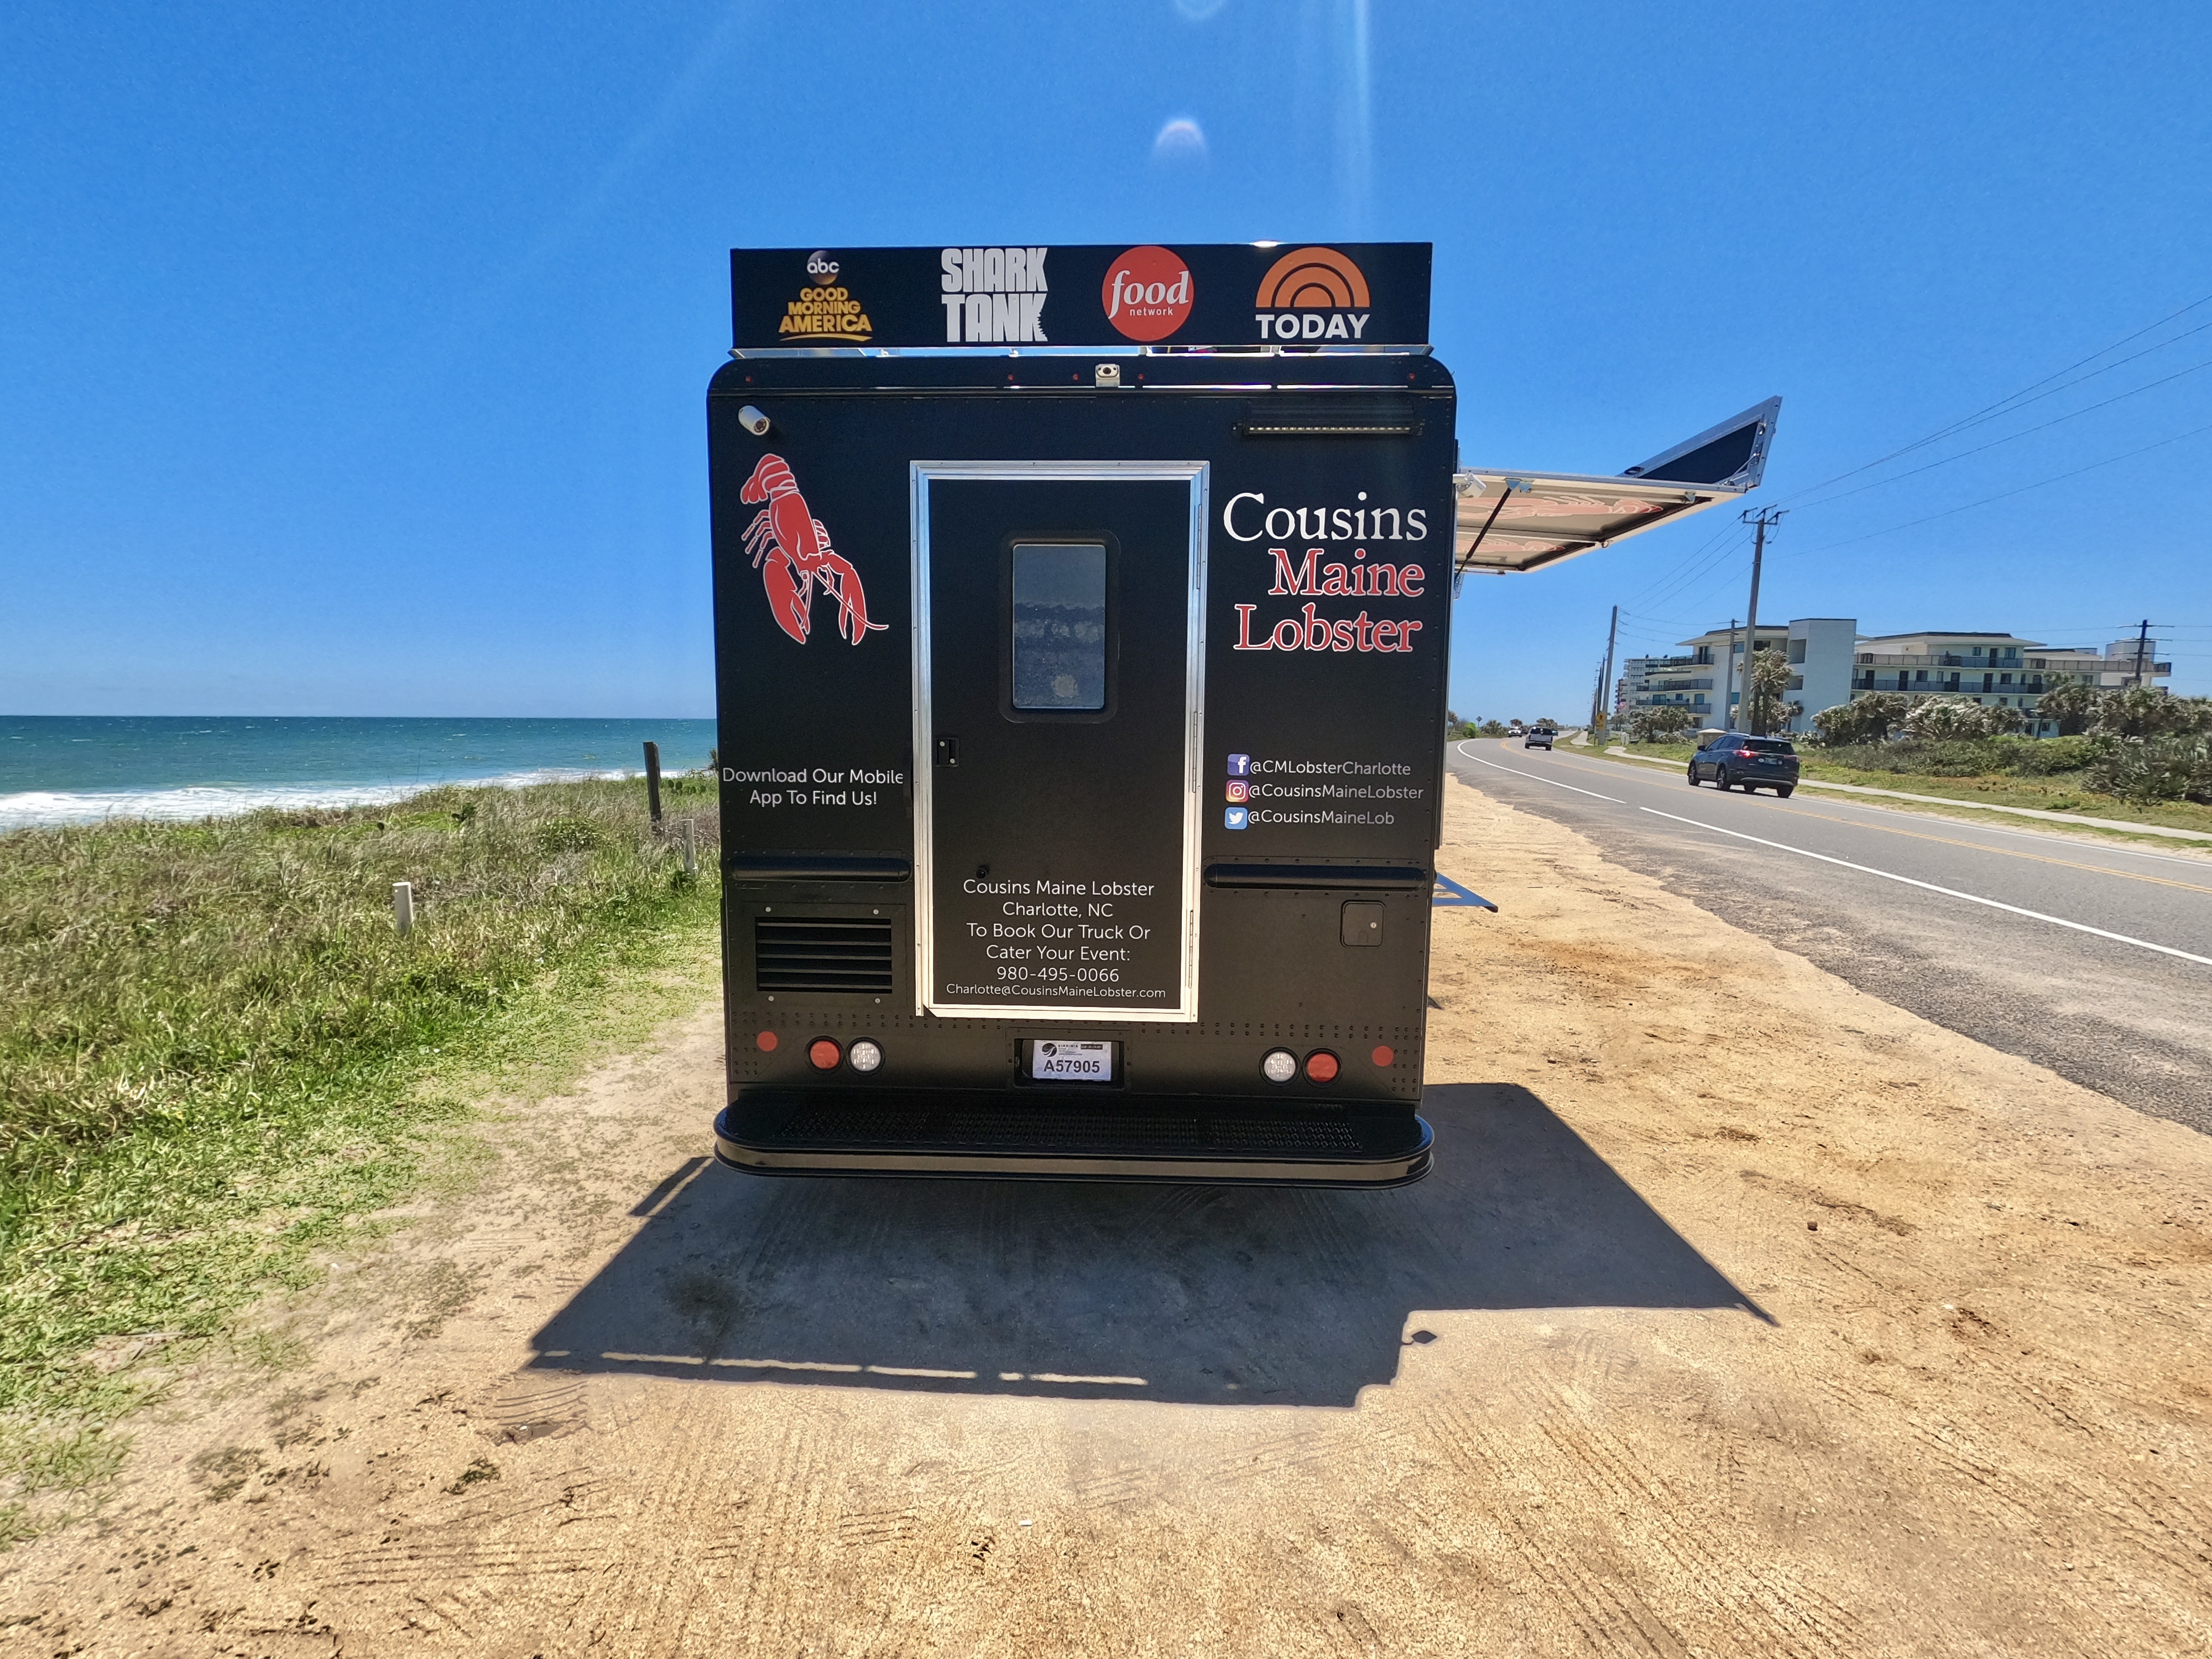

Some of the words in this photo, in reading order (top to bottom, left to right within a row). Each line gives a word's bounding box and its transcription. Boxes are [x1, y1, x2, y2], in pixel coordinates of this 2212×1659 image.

[807, 259, 839, 274] abc
[941, 248, 1047, 292] SHARK
[800, 288, 848, 301] GOOD
[1108, 270, 1189, 319] food
[788, 301, 860, 315] MORNING
[1129, 306, 1173, 316] network
[779, 315, 872, 333] AMERICA
[942, 294, 1047, 342] TANK
[1255, 314, 1370, 339] TODAY
[1223, 492, 1427, 541] Cousins
[1268, 548, 1425, 597] Maine
[1233, 602, 1423, 653] Lobster
[723, 768, 807, 782] Download
[812, 769, 844, 783] Our
[849, 769, 904, 784] Mobile
[1250, 760, 1411, 776] @CMLobsterCharlotte
[750, 790, 782, 807] App
[787, 790, 807, 805] To
[813, 791, 846, 805] Find
[852, 791, 877, 806] Us!
[1249, 784, 1424, 800] @CousinsMaineLobster
[1248, 810, 1394, 825] @CousinsMaineLob
[963, 879, 1030, 894] Cousins
[1036, 880, 1086, 895] Maine
[1092, 881, 1154, 896] Lobster
[1003, 902, 1082, 918] Charlotte,
[1088, 903, 1113, 917] NC
[967, 923, 987, 937] To
[993, 924, 1036, 938] Book
[1041, 924, 1073, 939] Our
[1078, 925, 1124, 940] Truck
[1129, 925, 1150, 940] Or
[986, 945, 1031, 959] Cater
[1036, 946, 1074, 960] Your
[1081, 946, 1130, 961] Event:
[997, 967, 1119, 982] 980-495-0066
[946, 983, 1166, 998] Charlotte@CousinsMaineLobster.com
[1044, 1060, 1100, 1073] A57905
